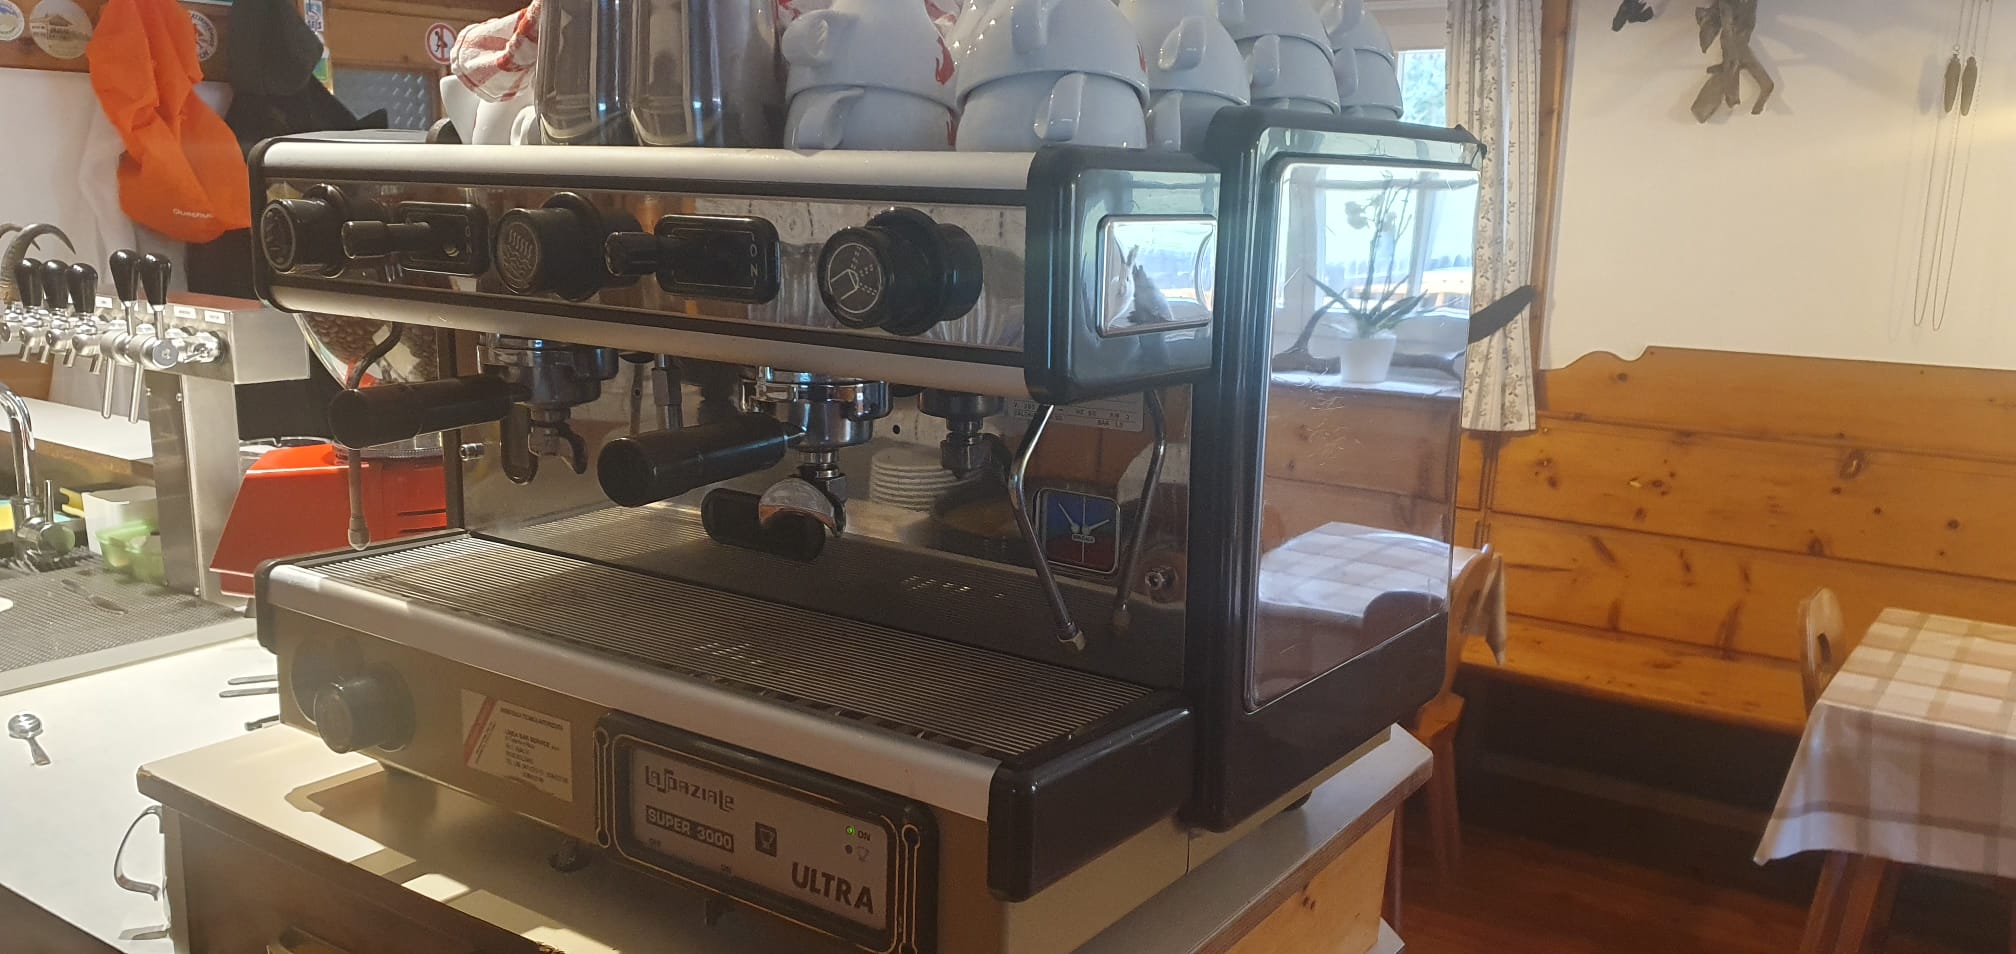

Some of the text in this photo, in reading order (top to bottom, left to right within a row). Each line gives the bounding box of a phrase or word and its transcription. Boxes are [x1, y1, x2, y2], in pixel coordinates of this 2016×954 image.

[749, 243, 759, 278] ON
[647, 808, 733, 850] SUPER 3000
[857, 830, 871, 841] ON
[791, 862, 875, 915] ULTRA
